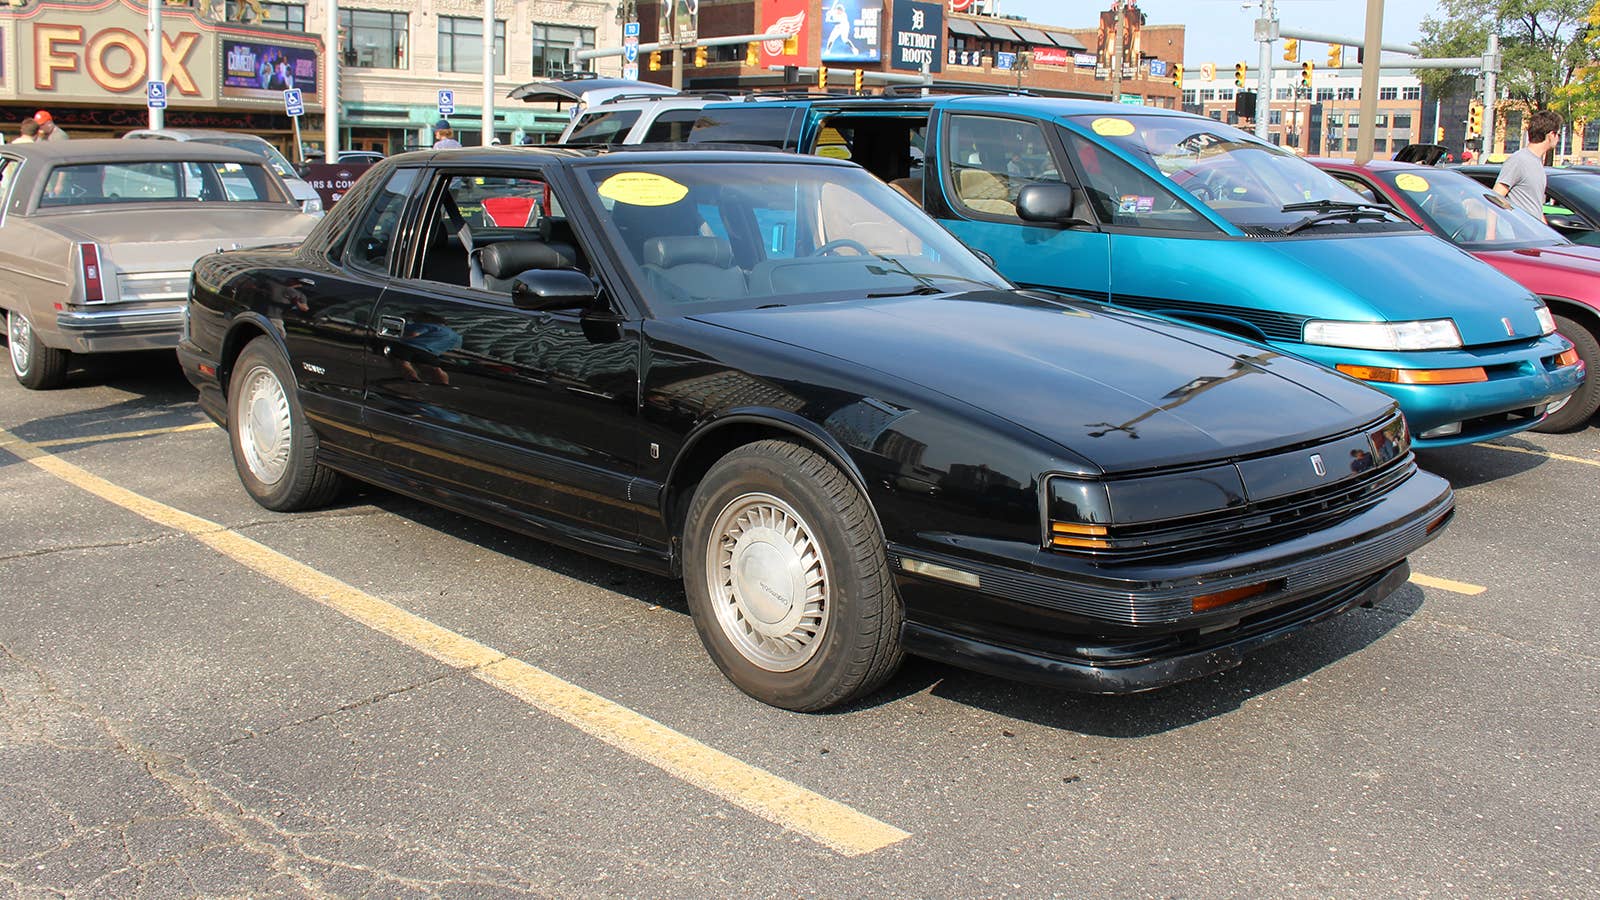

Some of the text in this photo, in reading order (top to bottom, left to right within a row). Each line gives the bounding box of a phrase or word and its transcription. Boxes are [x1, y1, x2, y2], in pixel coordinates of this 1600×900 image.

[898, 31, 937, 49] DETROIT
[33, 22, 202, 97] FOX
[625, 45, 637, 60] 75
[902, 48, 932, 65] ROOTS
[228, 51, 256, 73] COMEDY
